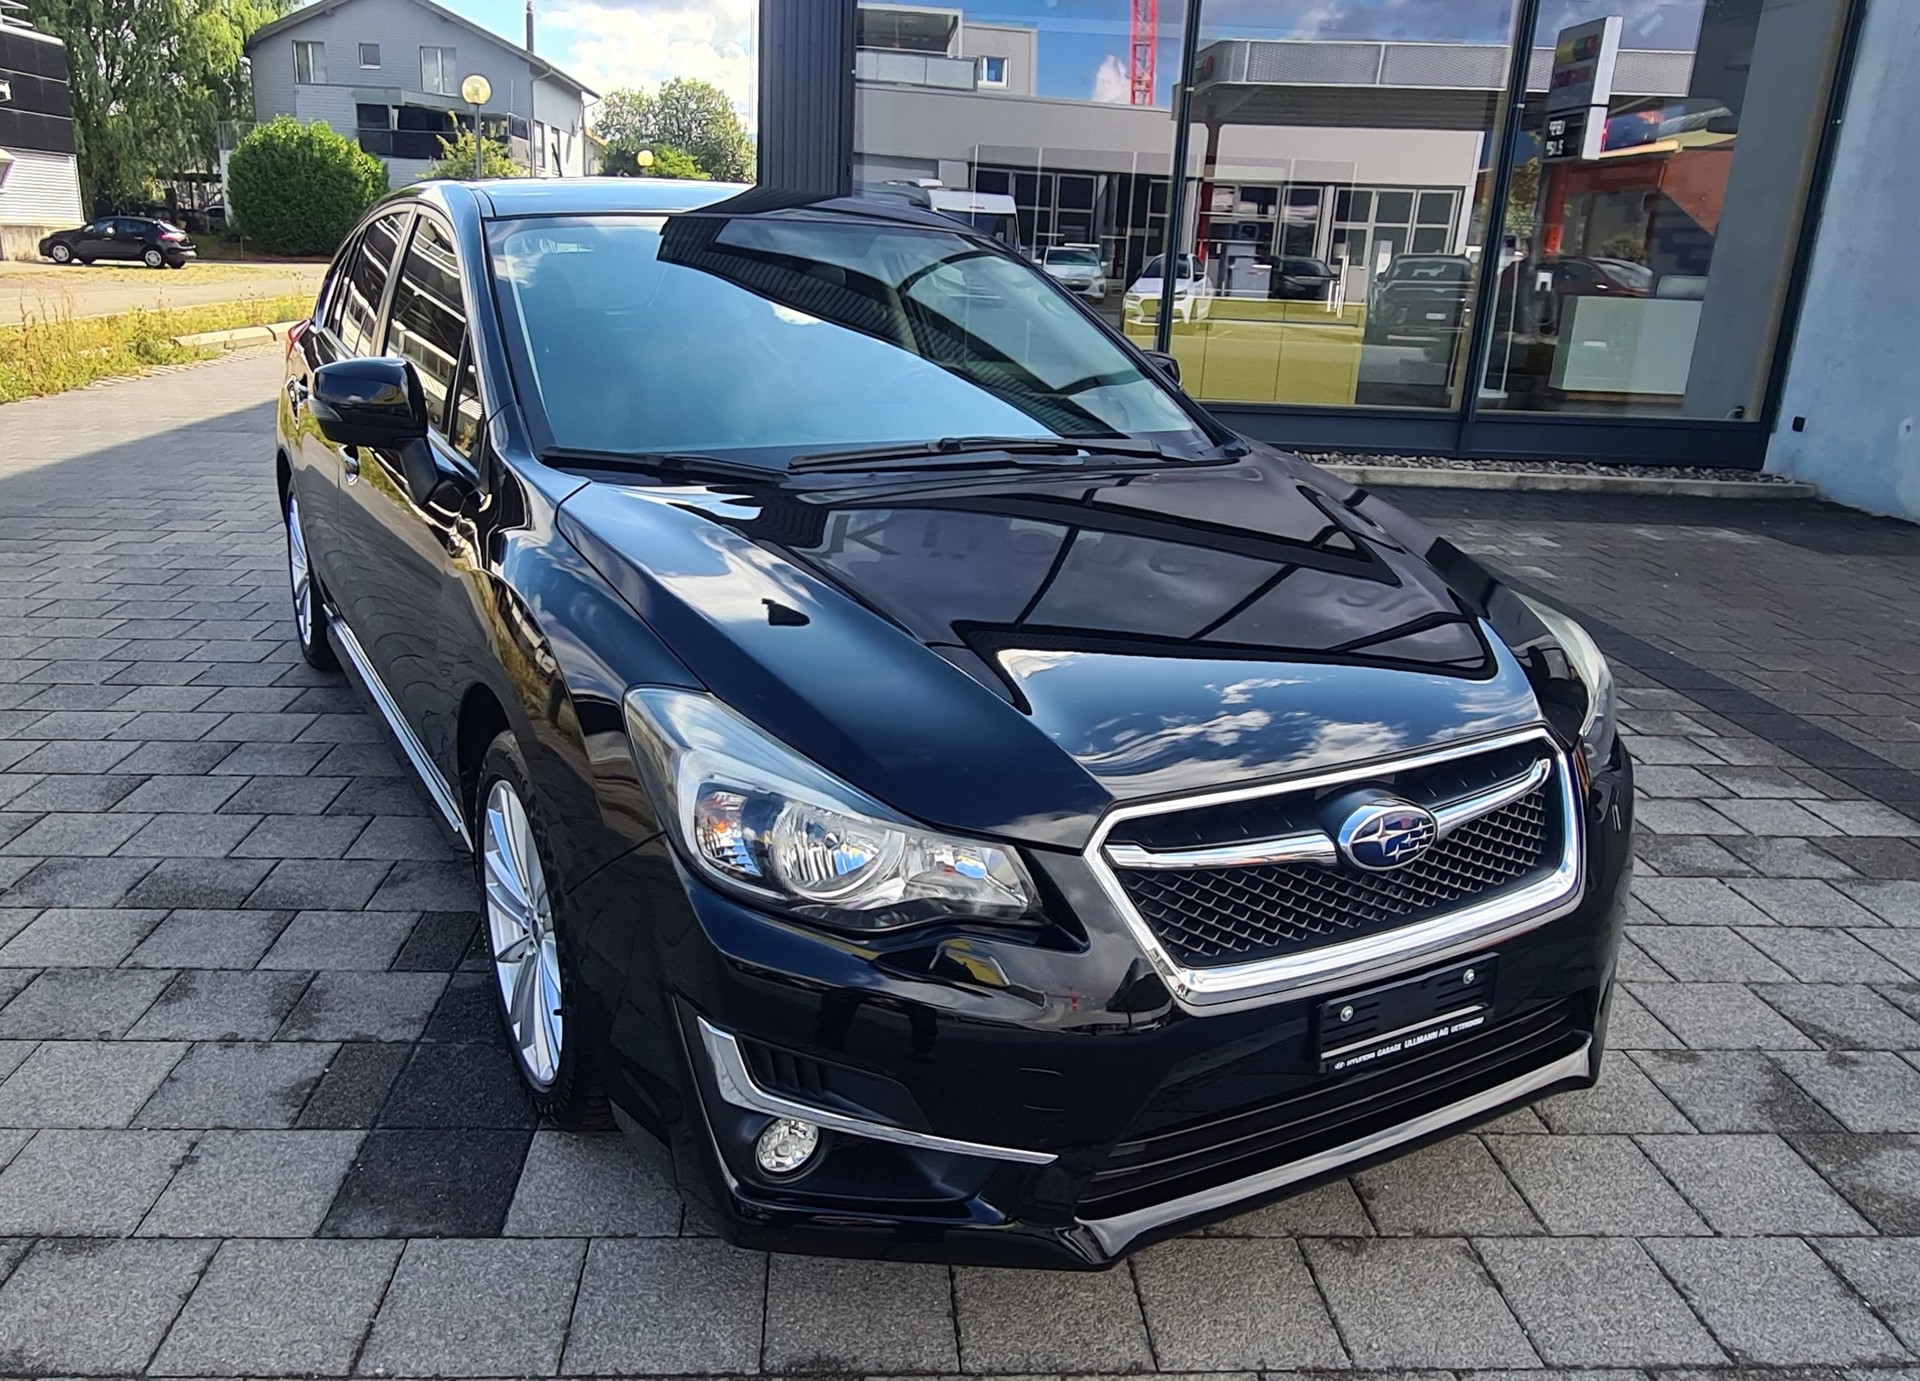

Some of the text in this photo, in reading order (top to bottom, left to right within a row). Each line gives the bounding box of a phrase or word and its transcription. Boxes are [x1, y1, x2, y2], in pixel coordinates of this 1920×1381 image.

[1376, 1042, 1402, 1058] GARAGE
[1404, 1030, 1439, 1049] ULLMANN
[1438, 1027, 1449, 1038] AG
